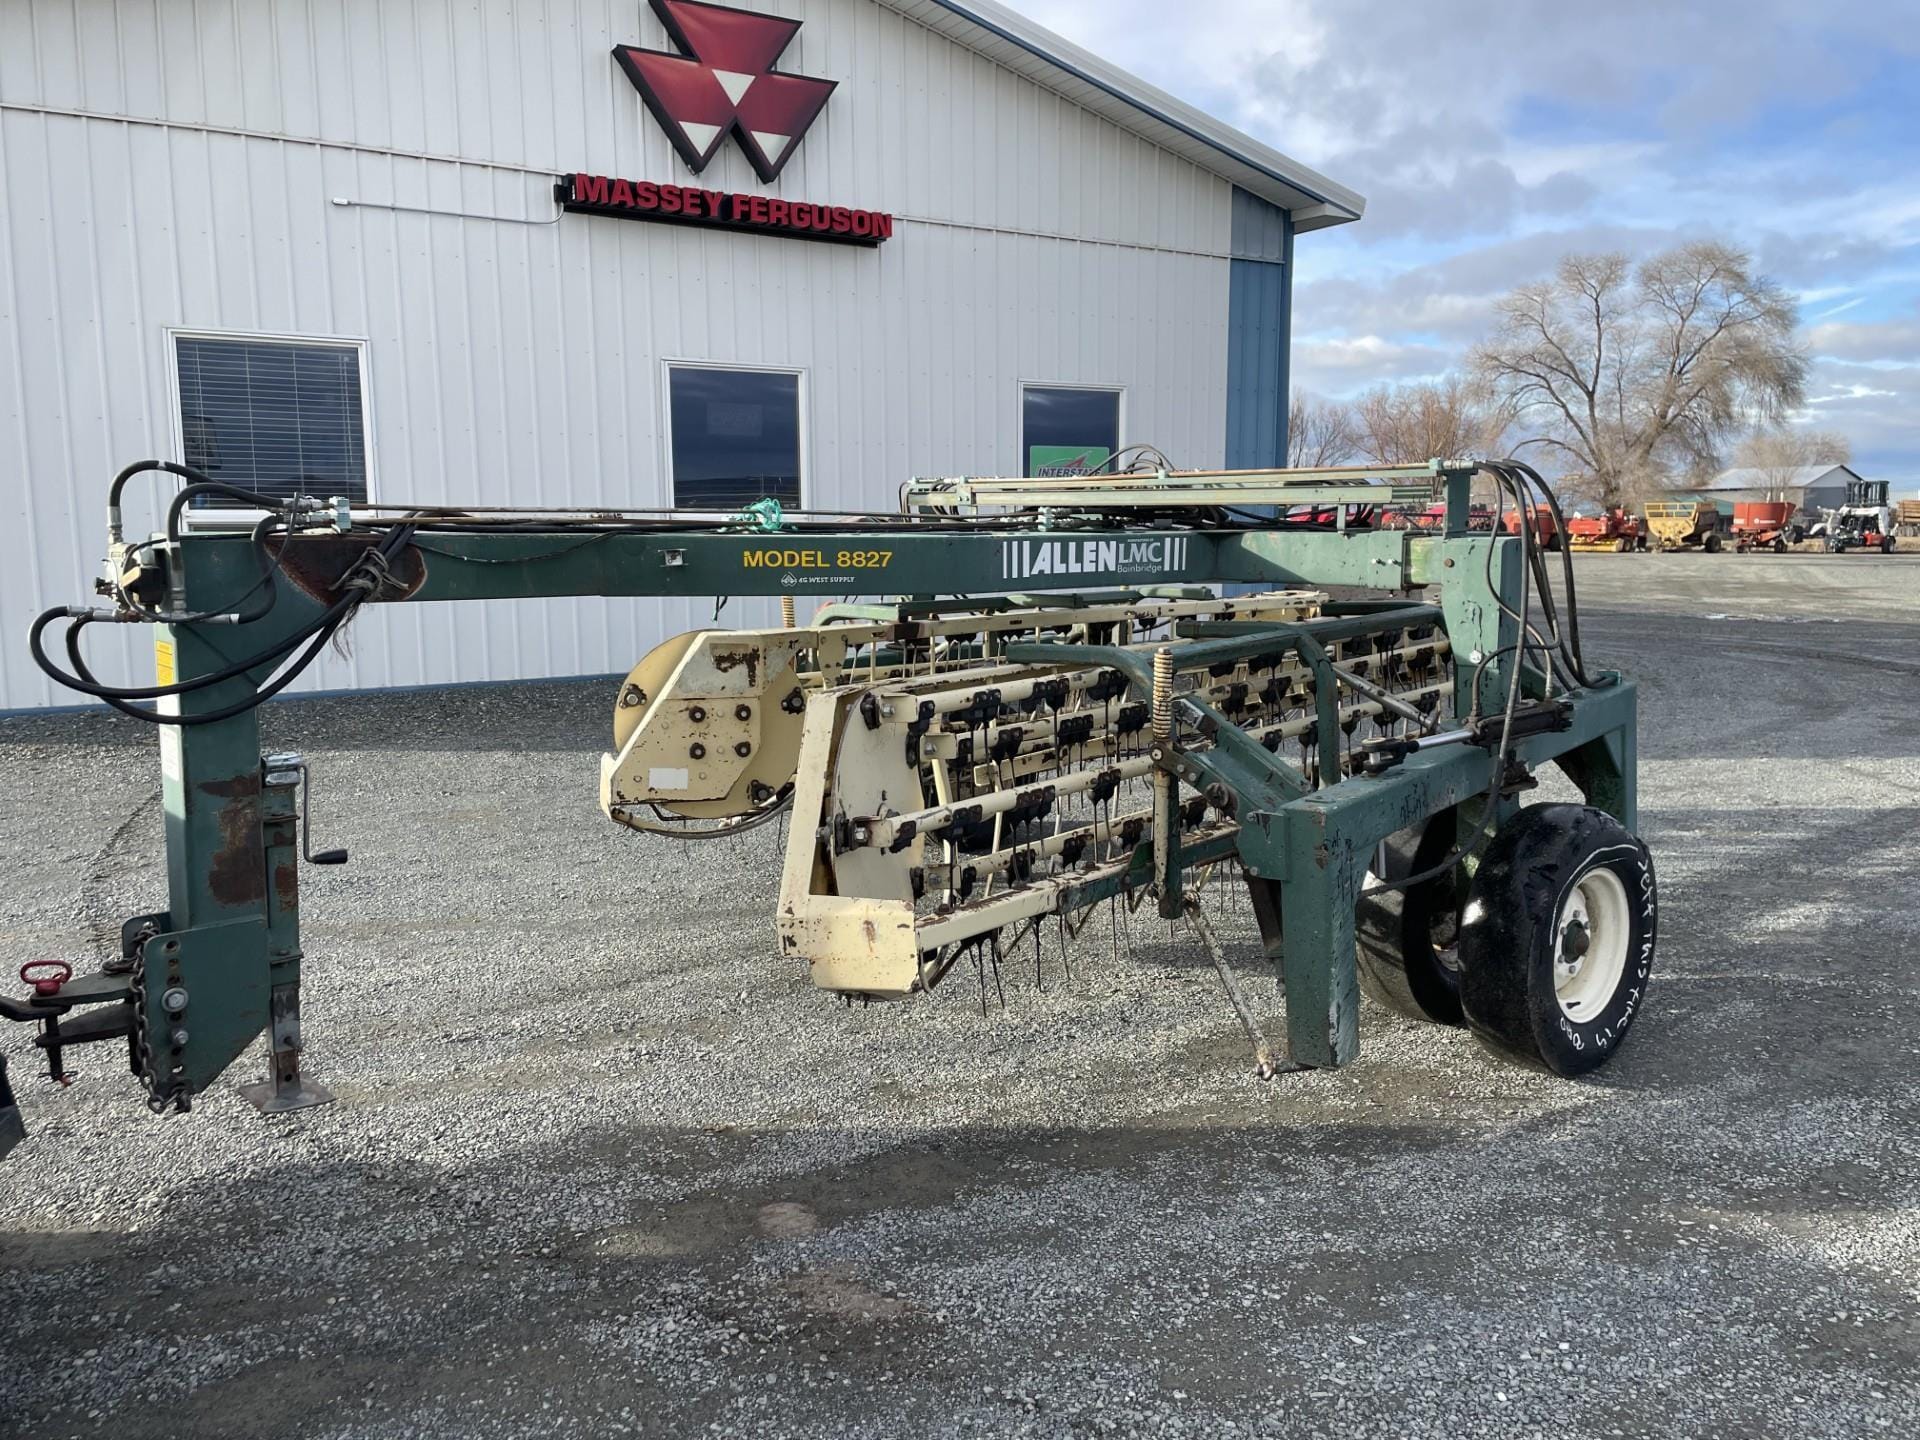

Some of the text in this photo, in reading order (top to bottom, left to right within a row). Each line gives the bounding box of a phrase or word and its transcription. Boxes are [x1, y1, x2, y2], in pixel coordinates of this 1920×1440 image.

[574, 173, 893, 239] MASSEY FERGUSON
[743, 550, 893, 568] MODEL 8827
[1030, 540, 1116, 575] ALLEN
[1118, 542, 1162, 563] LMC
[1117, 563, 1162, 574] Bainbridge
